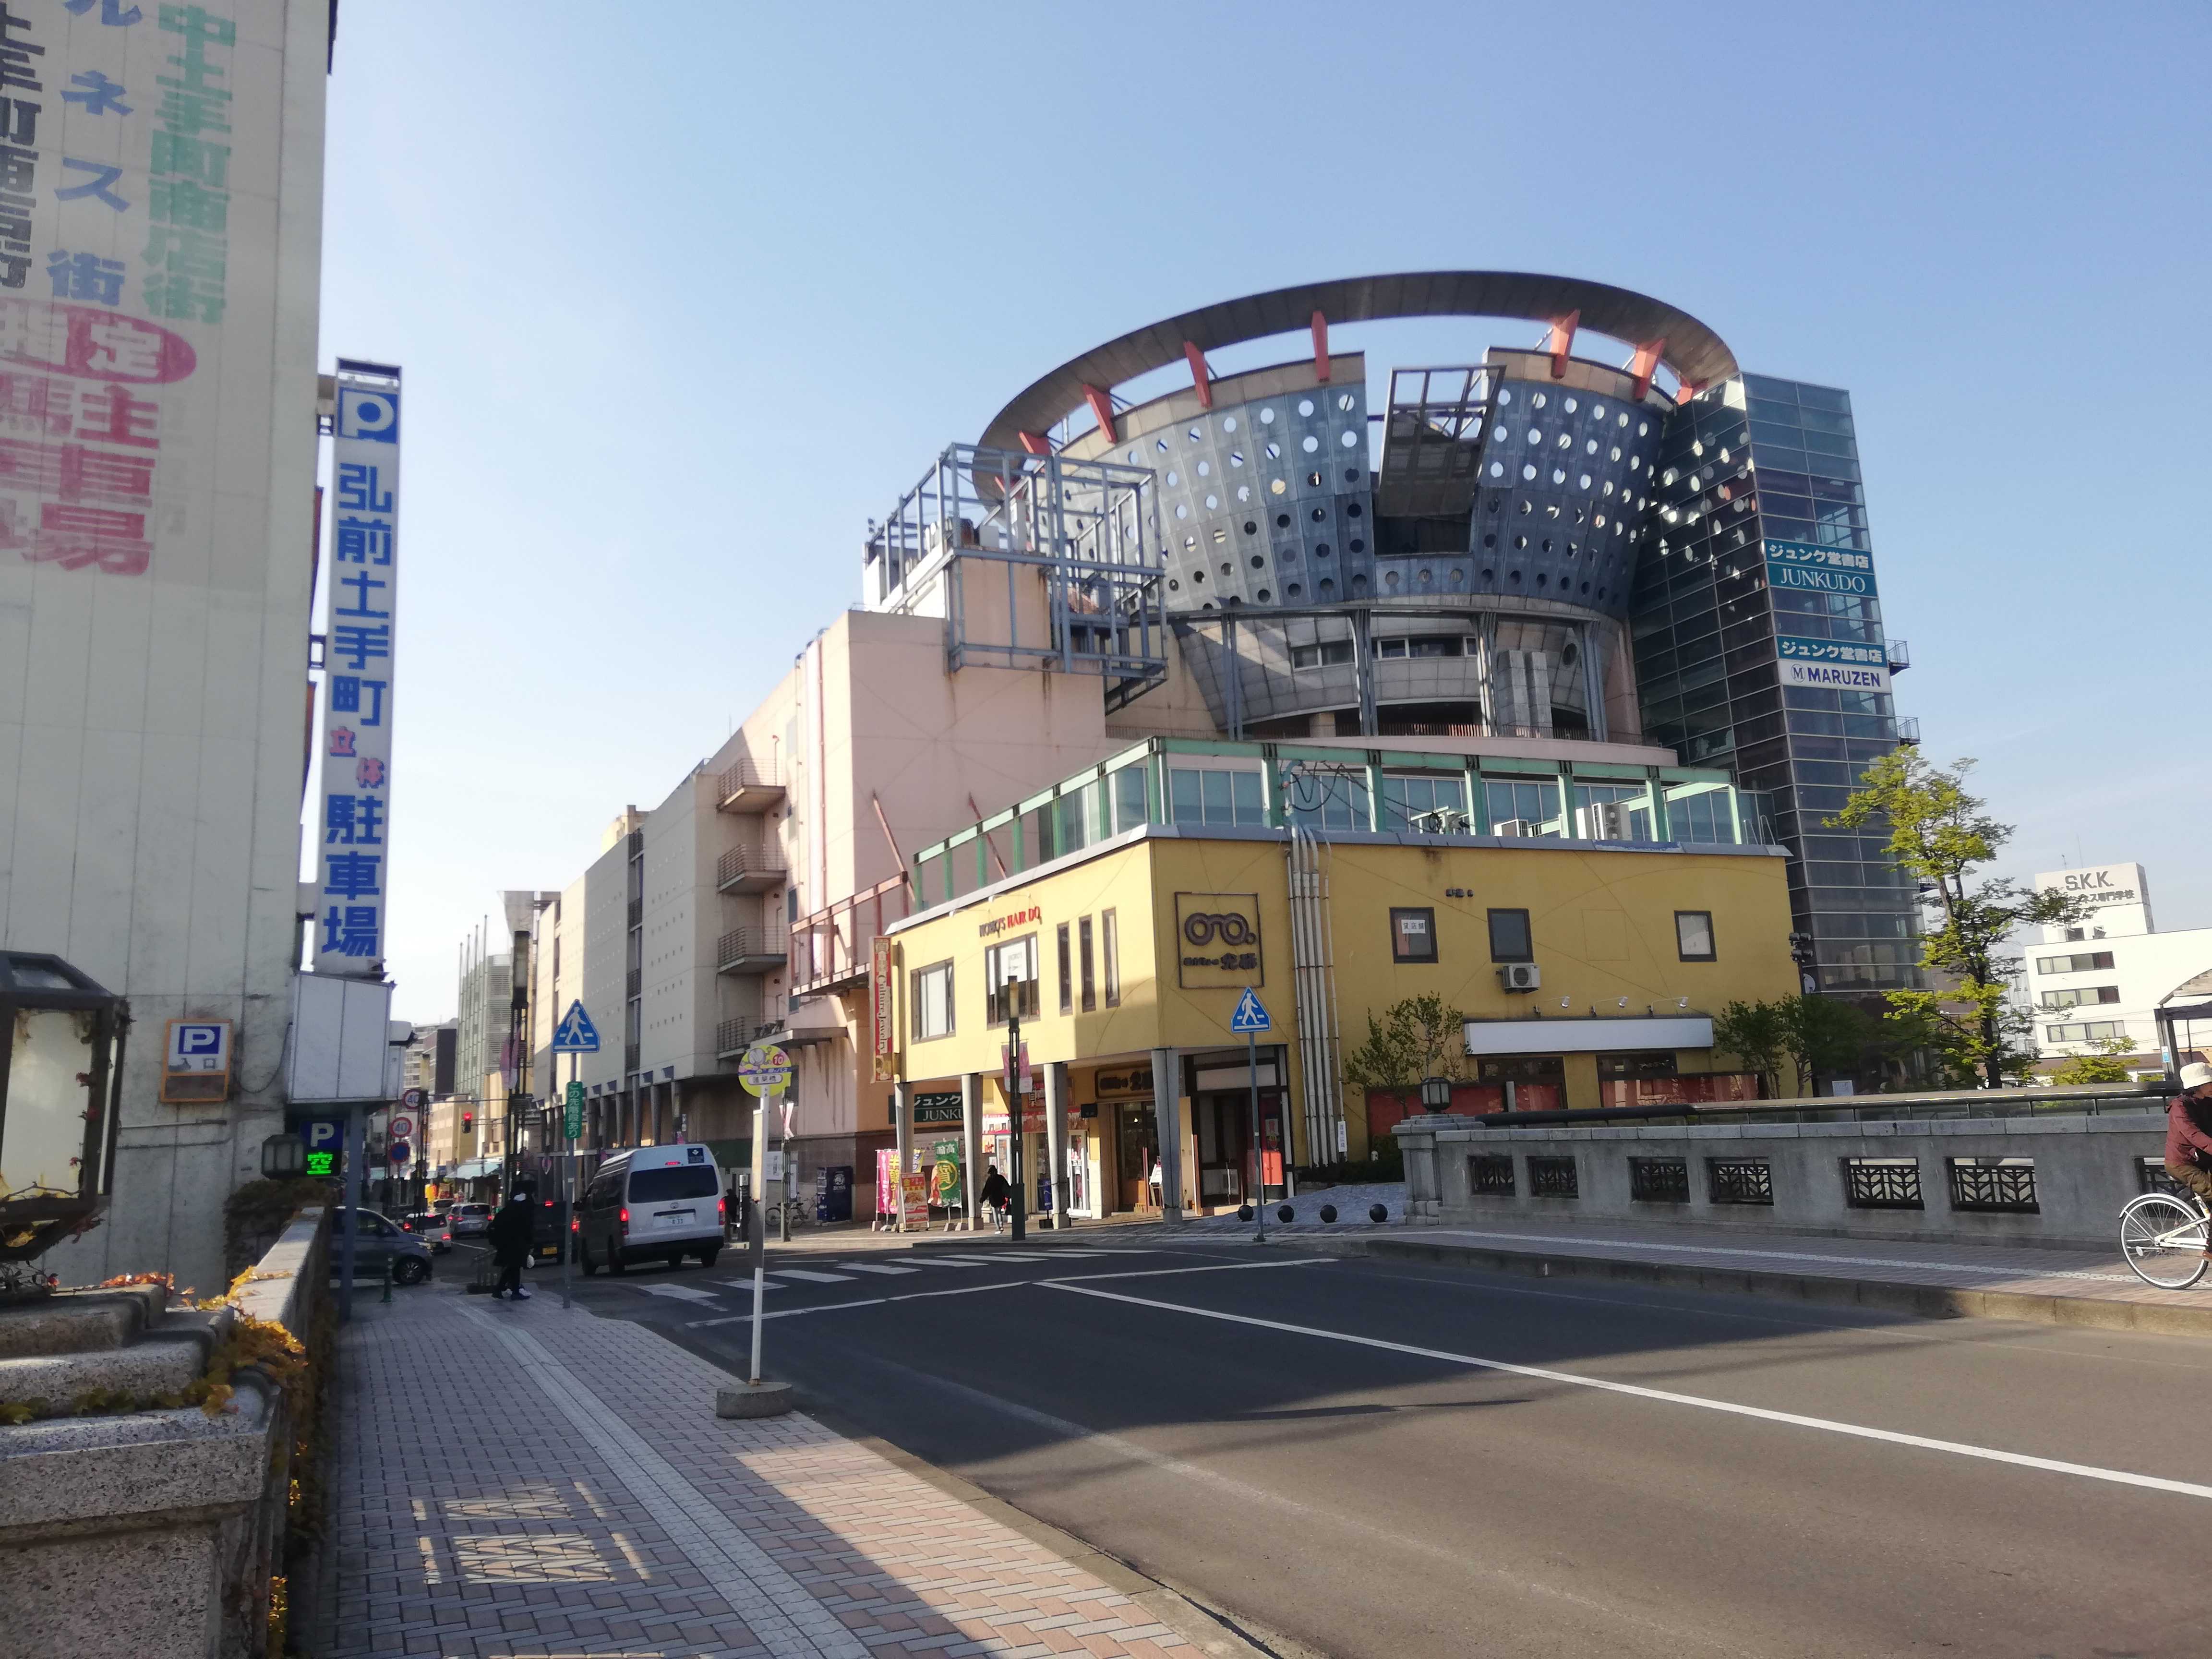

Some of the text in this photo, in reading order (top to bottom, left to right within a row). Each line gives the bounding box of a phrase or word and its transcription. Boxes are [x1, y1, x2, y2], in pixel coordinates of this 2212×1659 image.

[140, 2, 236, 324] 中土手町商店街
[341, 390, 394, 439] P
[1769, 543, 1869, 568] ジュンク堂書店
[1780, 568, 1866, 593] JUNKUDO
[1781, 641, 1883, 663] ジュンク堂書店
[1808, 667, 1881, 687] MARUZEN
[1008, 911, 1027, 928] HAIR
[183, 1028, 216, 1052] P
[774, 1056, 784, 1065] 10
[311, 1123, 334, 1147] P
[395, 1123, 408, 1132] 40
[307, 1152, 333, 1175] 空
